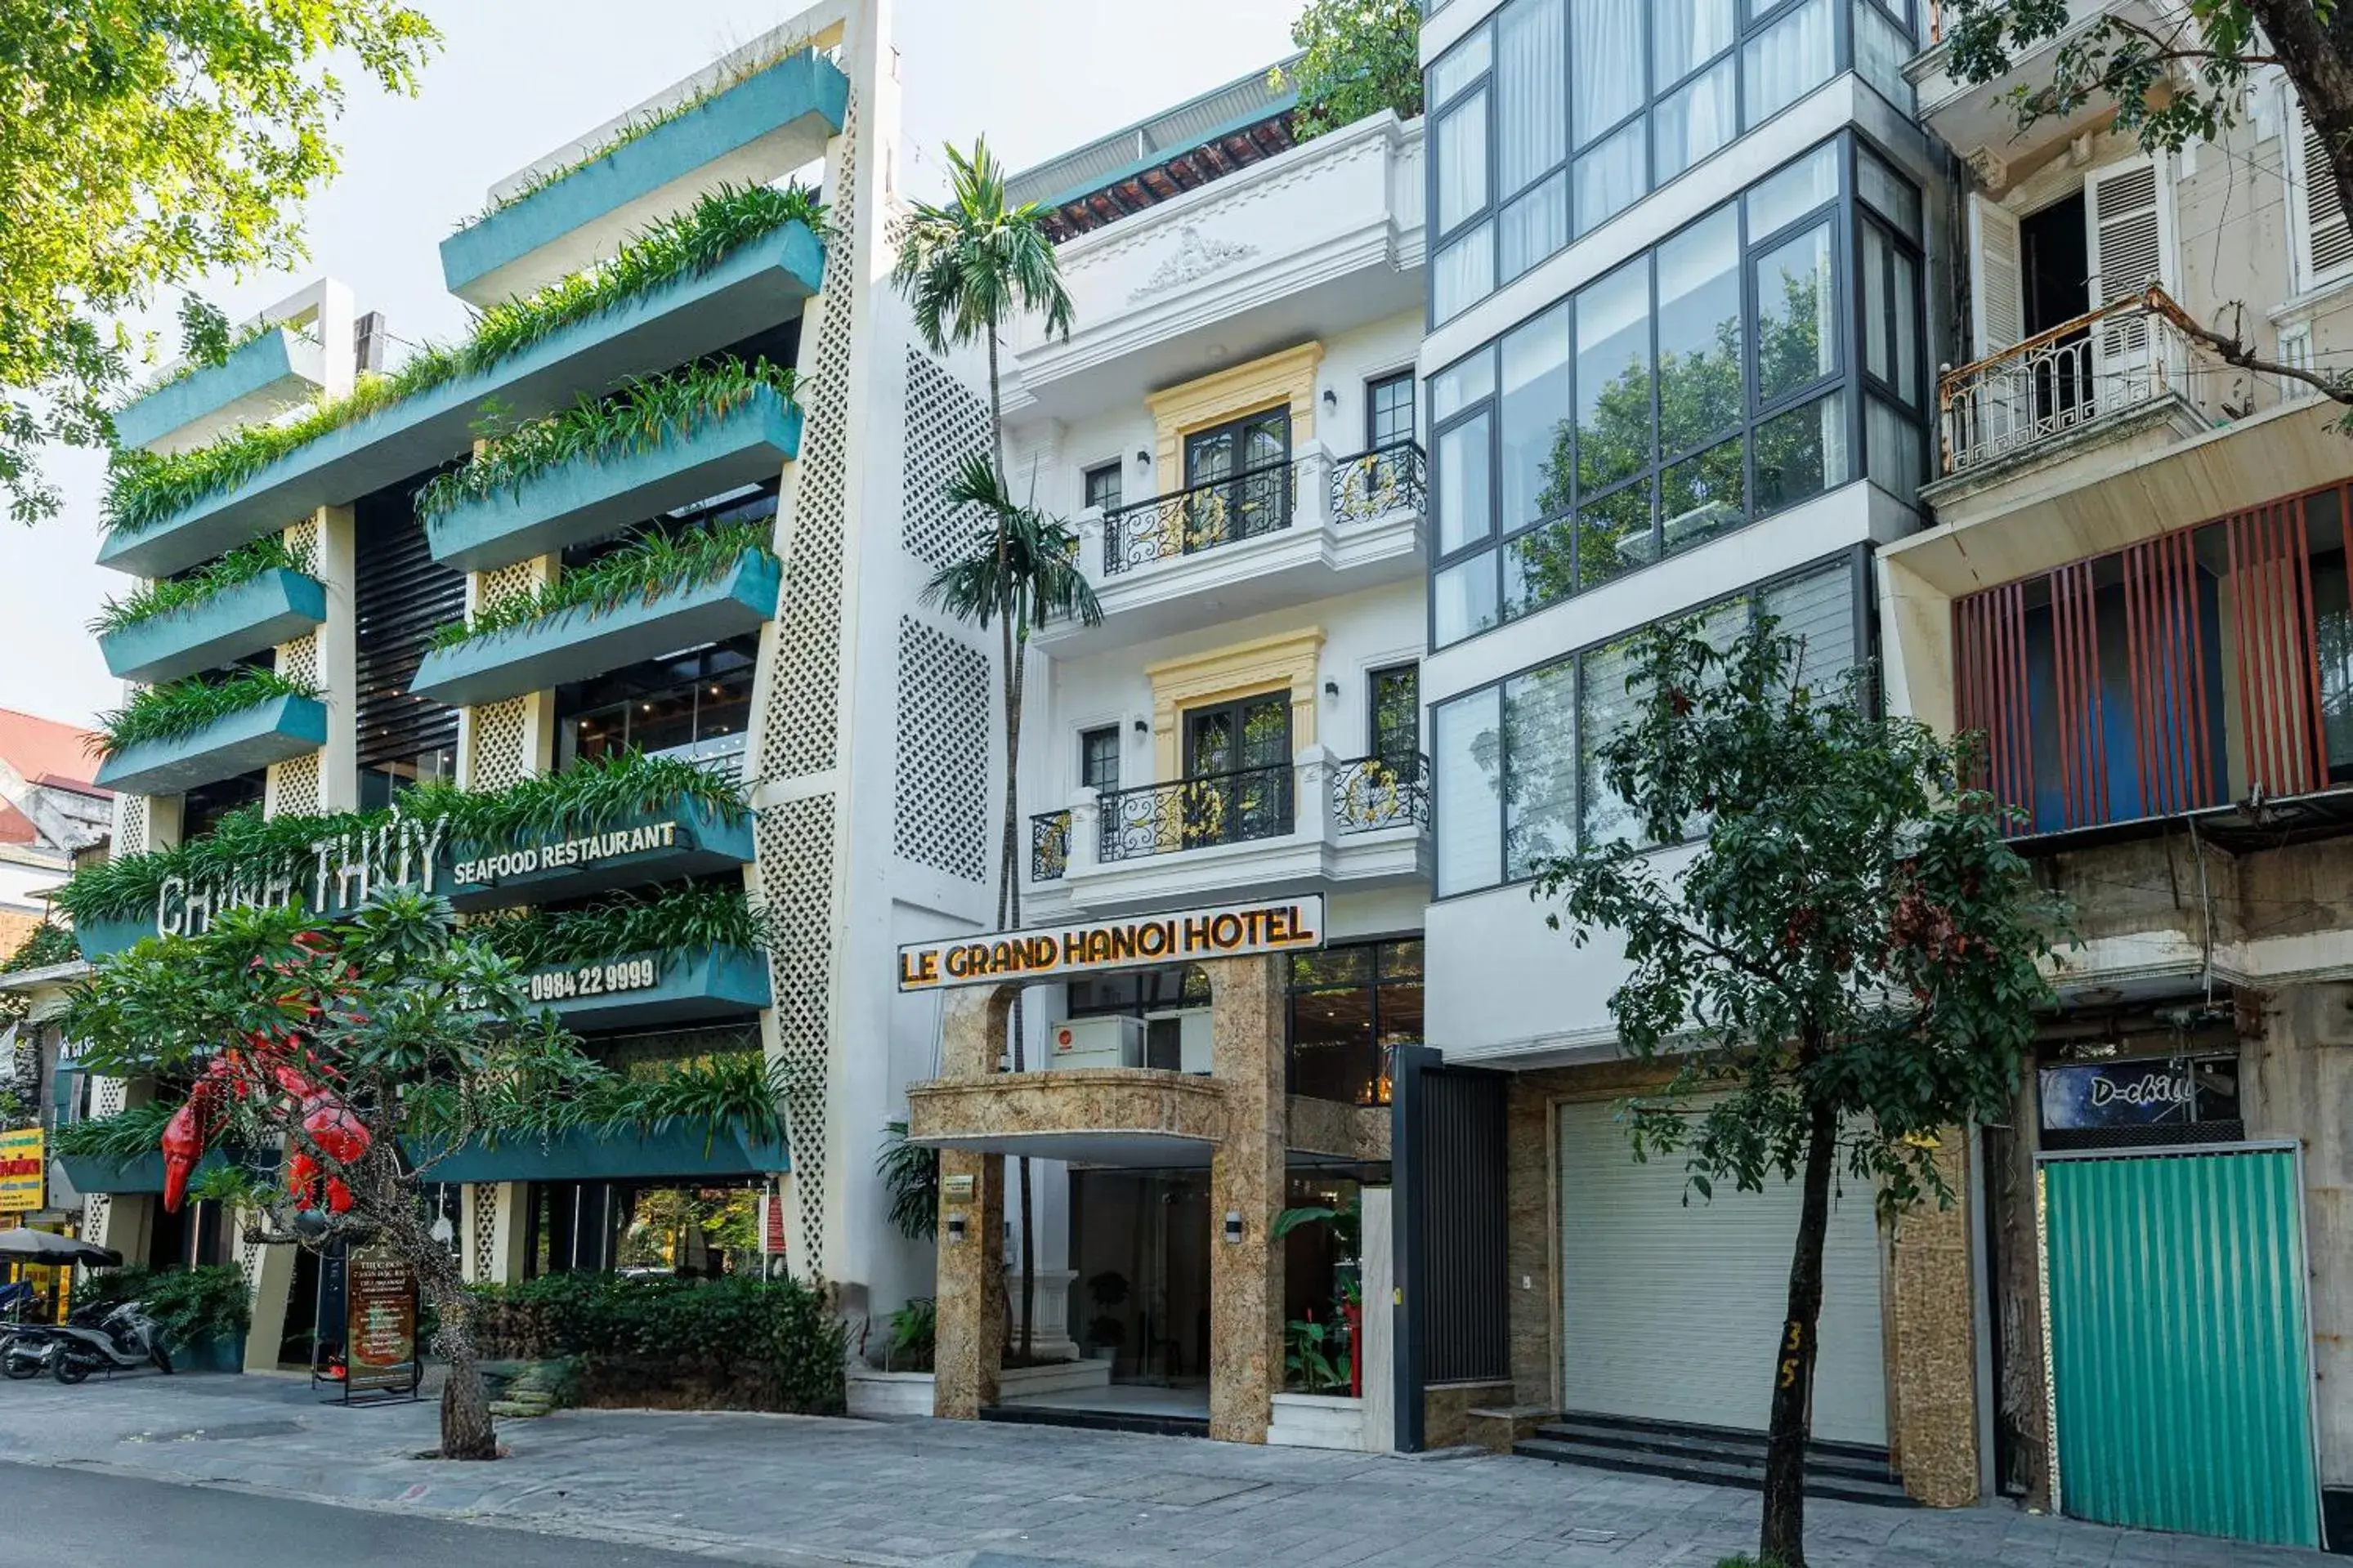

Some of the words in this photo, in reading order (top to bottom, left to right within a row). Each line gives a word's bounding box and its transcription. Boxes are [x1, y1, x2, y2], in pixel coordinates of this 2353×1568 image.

[454, 852, 537, 885] SEAFOOD
[541, 821, 677, 869] RESTAURANT
[901, 950, 939, 984] LE
[945, 936, 1059, 979] GRAND
[1062, 919, 1177, 965] HANOI
[1183, 905, 1315, 953] HOTEL
[531, 972, 576, 1000] 0984
[579, 966, 602, 994] 22
[606, 958, 653, 991] 9999
